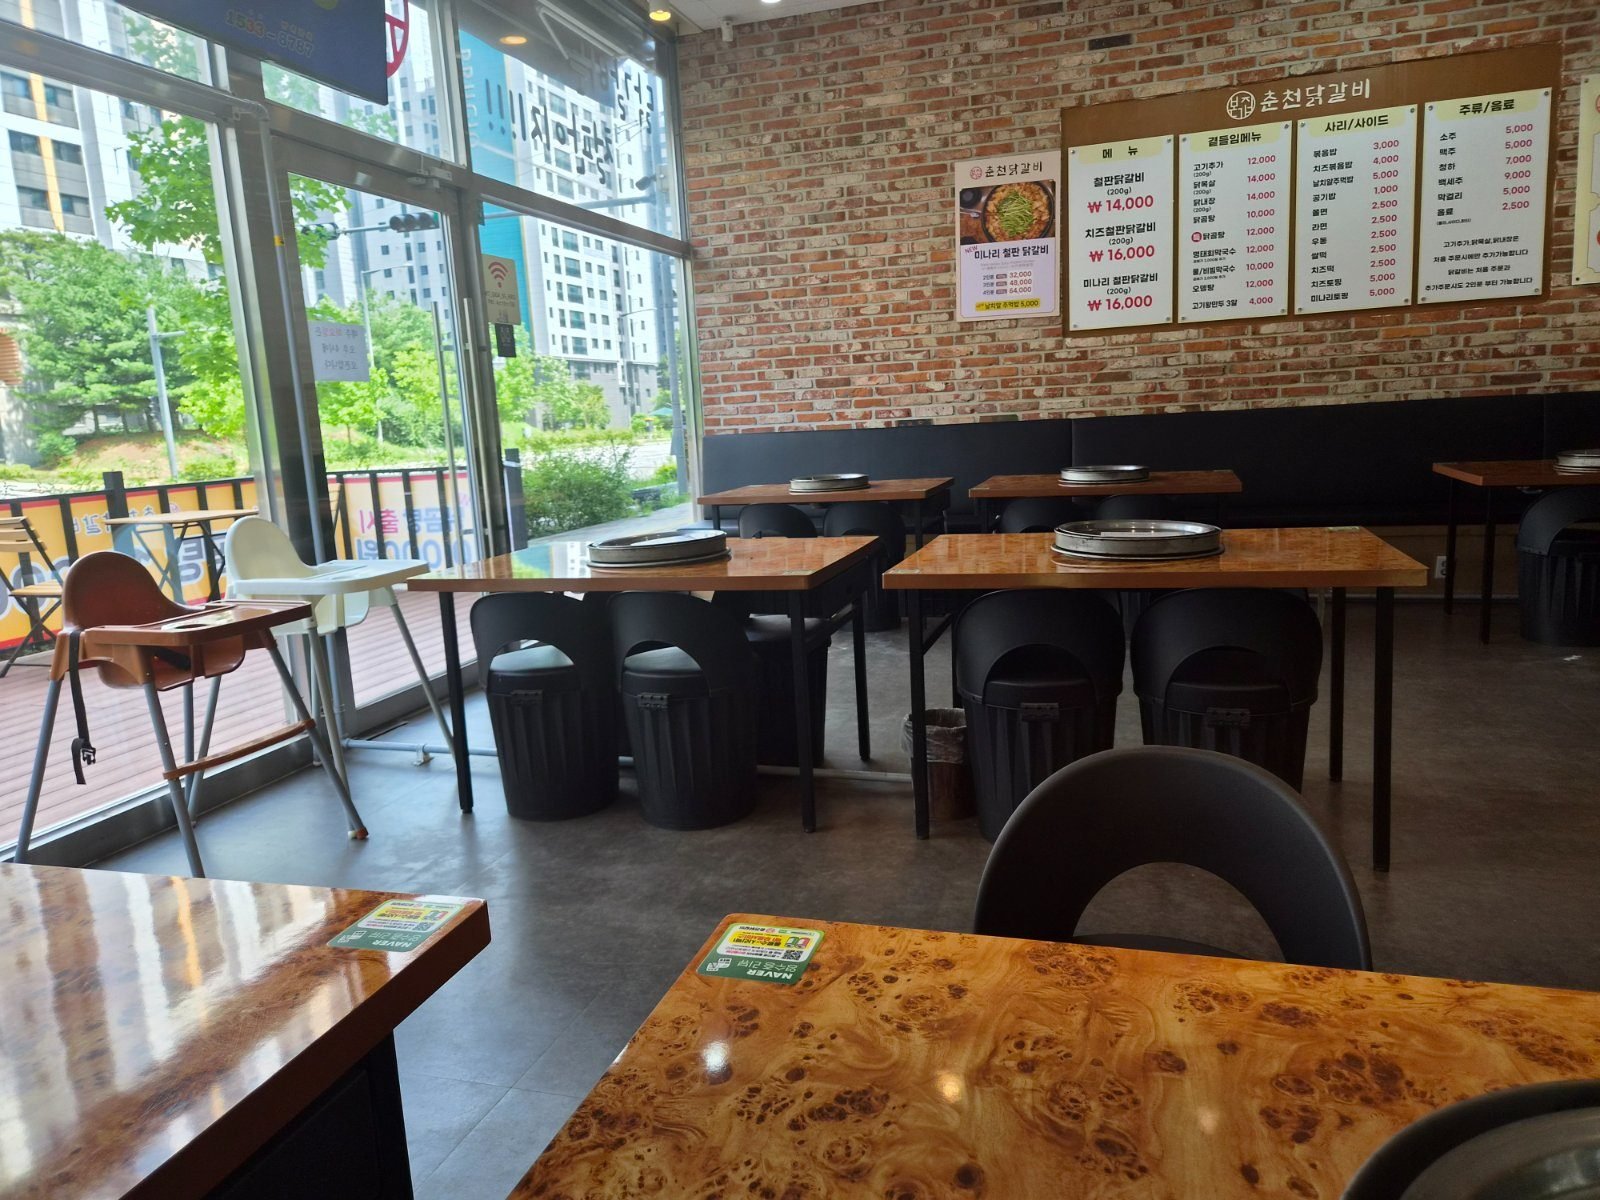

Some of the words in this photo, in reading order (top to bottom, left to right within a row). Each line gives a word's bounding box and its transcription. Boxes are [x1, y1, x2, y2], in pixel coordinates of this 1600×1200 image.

[1260, 78, 1370, 112] 춘천닭갈비
[1459, 99, 1515, 115] 주류/음료
[1325, 115, 1389, 132] 사리/사이드
[1208, 131, 1261, 147] 곁들임메뉴
[1439, 132, 1457, 141] 소주
[1506, 124, 1533, 134] 5,000
[1313, 149, 1337, 158] 볶음밥
[1373, 140, 1399, 150] 3,000
[1439, 148, 1456, 156] 맥주
[1505, 139, 1533, 150] 5,000
[985, 162, 1042, 177] 춘천닭갈비
[1193, 162, 1224, 172] 고기추가
[1248, 155, 1276, 165] 12,000
[1313, 161, 1353, 173] 치즈볶음밥
[1373, 155, 1399, 165] 4,000
[1439, 163, 1456, 171] 청하
[1506, 155, 1532, 165] 7,000
[1093, 172, 1144, 188] 철판닭갈비
[1247, 173, 1276, 183] 14,000
[1313, 176, 1354, 187] 날치알주먹밥
[1373, 170, 1398, 180] 5,000
[1438, 177, 1463, 186] 백세주
[1504, 170, 1531, 180] 9,000
[1107, 187, 1132, 195] (200g)
[1313, 192, 1336, 202] 공기밥
[1374, 185, 1398, 194] 1,000
[1437, 192, 1463, 201] 막걸리
[1503, 186, 1530, 196] 5,000
[1106, 195, 1154, 212] 14,000
[1193, 197, 1216, 207] 닭내장
[1247, 191, 1275, 201] 14,000
[1372, 200, 1398, 210] 2,500
[1193, 215, 1216, 224] 닭곰탕
[1247, 209, 1275, 219] 10,000
[1437, 208, 1454, 217] 음료
[1502, 201, 1530, 211] 2,500
[1085, 222, 1156, 239] 치즈철판닭갈비
[1312, 223, 1327, 231] 라면
[1371, 215, 1397, 224] 2,500
[1109, 237, 1134, 245] (200g)
[1203, 231, 1225, 241] 닭곰탕
[1247, 227, 1275, 237] 12,000
[1311, 238, 1327, 246] 우동
[1371, 229, 1397, 239] 2,500
[975, 249, 1000, 260] 미나리
[1003, 247, 1020, 258] 철판
[1022, 244, 1048, 256] 닭갈비
[1108, 245, 1155, 261] 16,000
[1193, 248, 1236, 259] 명태회막국수
[1246, 244, 1274, 254] 12,000
[1371, 244, 1396, 254] 2,500
[1482, 249, 1529, 259] 추가가능합니다
[1246, 262, 1274, 272] 10,000
[1311, 265, 1335, 274] 치즈떡
[1370, 259, 1396, 268] 2,500
[1083, 277, 1110, 288] 미나리
[1113, 273, 1158, 286] 철판닭갈비
[1246, 279, 1273, 289] 12,000
[1311, 279, 1342, 289] 치즈토핑
[1370, 273, 1395, 282] 5,000
[1465, 280, 1483, 288] 2인분
[1499, 277, 1533, 286] 가능합니다
[1106, 287, 1131, 296] (200g)
[1311, 293, 1349, 303] 미나리토핑
[1369, 288, 1395, 297] 5,000
[1105, 295, 1153, 310] 16,000
[1249, 296, 1273, 305] 4,000
[372, 940, 412, 948] NAVER
[747, 969, 793, 979] NAVER
[764, 962, 798, 972] 영수증
